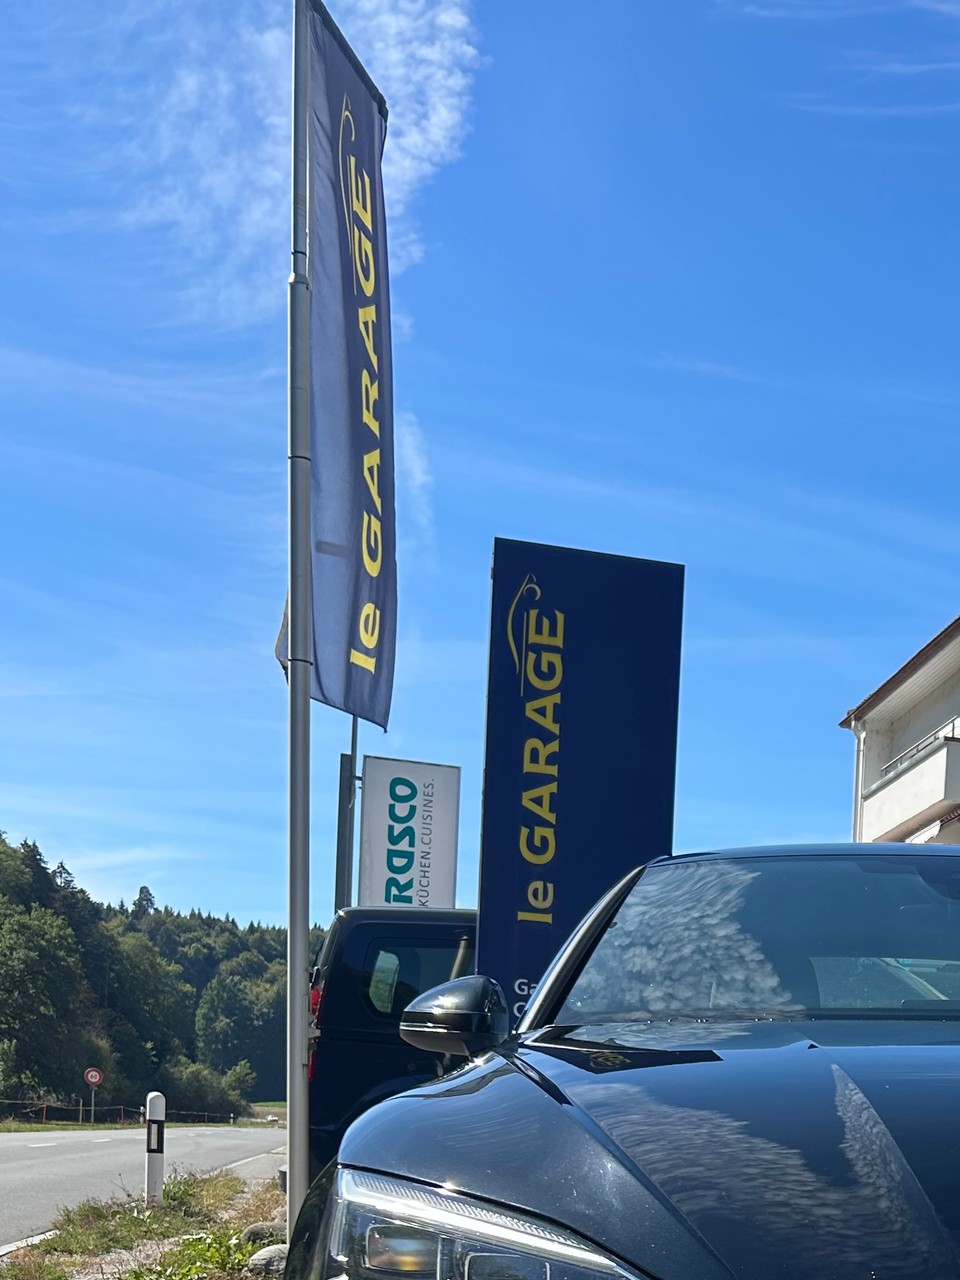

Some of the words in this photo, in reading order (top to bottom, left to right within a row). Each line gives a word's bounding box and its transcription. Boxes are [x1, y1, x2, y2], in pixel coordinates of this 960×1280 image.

[349, 154, 383, 578] GARAGE
[350, 602, 380, 675] le
[519, 608, 565, 865] GARAGE
[517, 879, 554, 925] le
